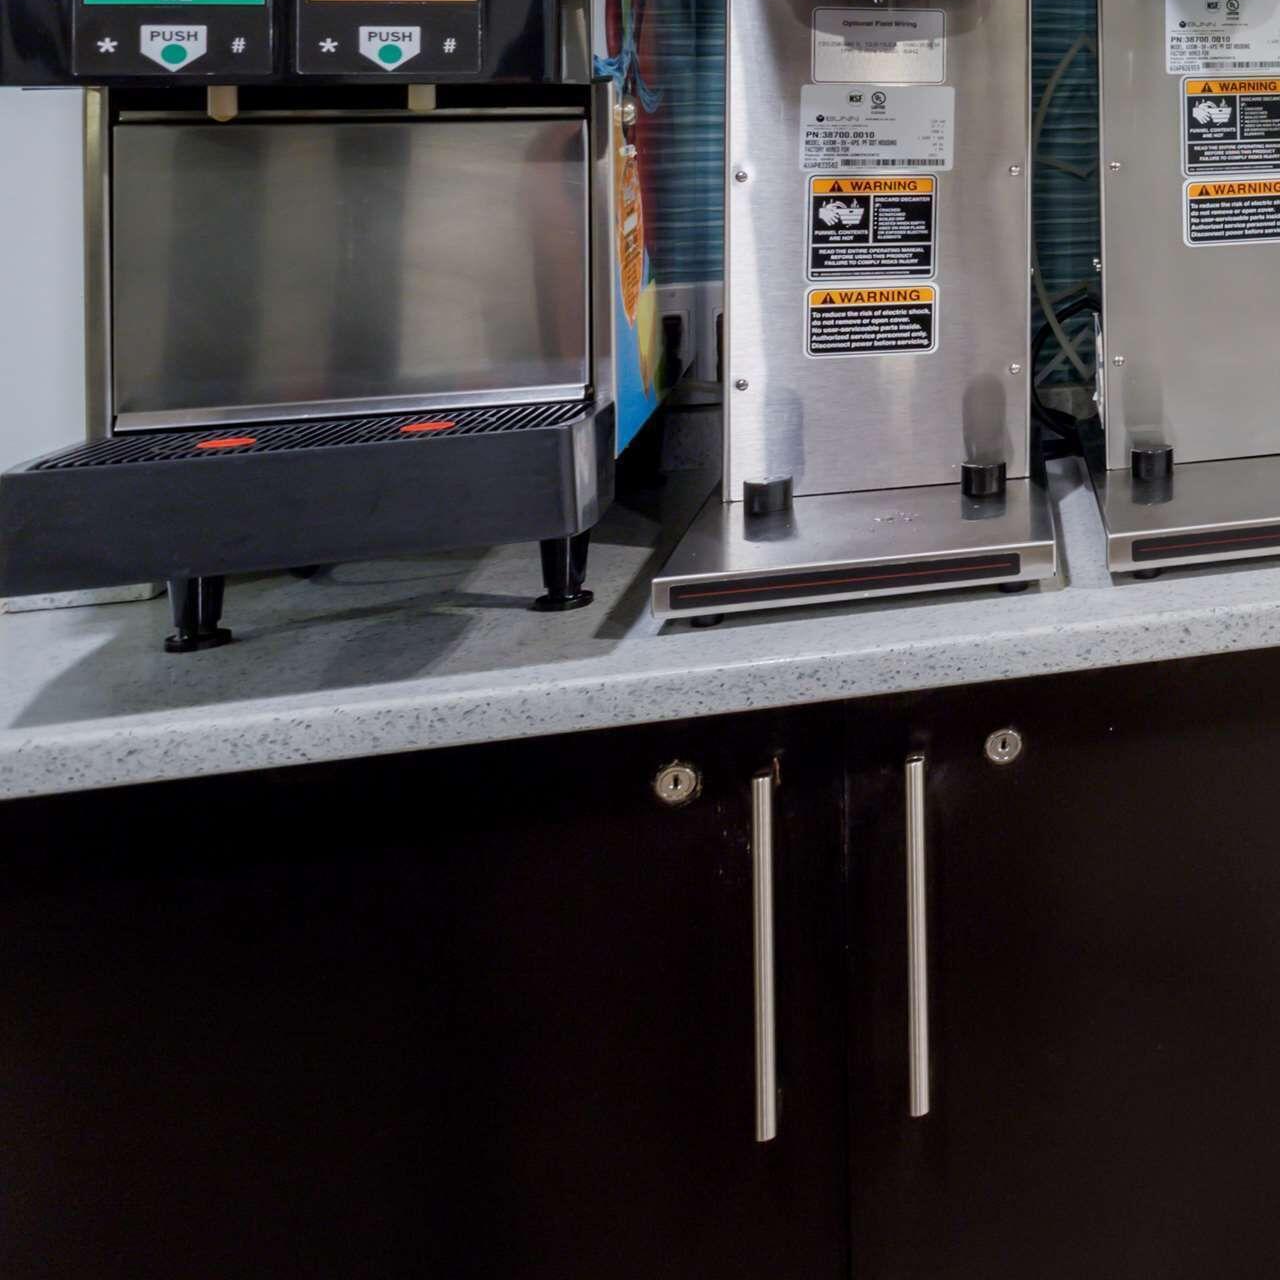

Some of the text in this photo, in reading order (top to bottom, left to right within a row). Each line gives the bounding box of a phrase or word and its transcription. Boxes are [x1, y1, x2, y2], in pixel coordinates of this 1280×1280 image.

[150, 31, 198, 42] PUSH
[367, 31, 413, 42] PUSH
[1218, 82, 1277, 92] WARNING
[850, 181, 918, 191] WARNING
[839, 290, 920, 304] WARNING
